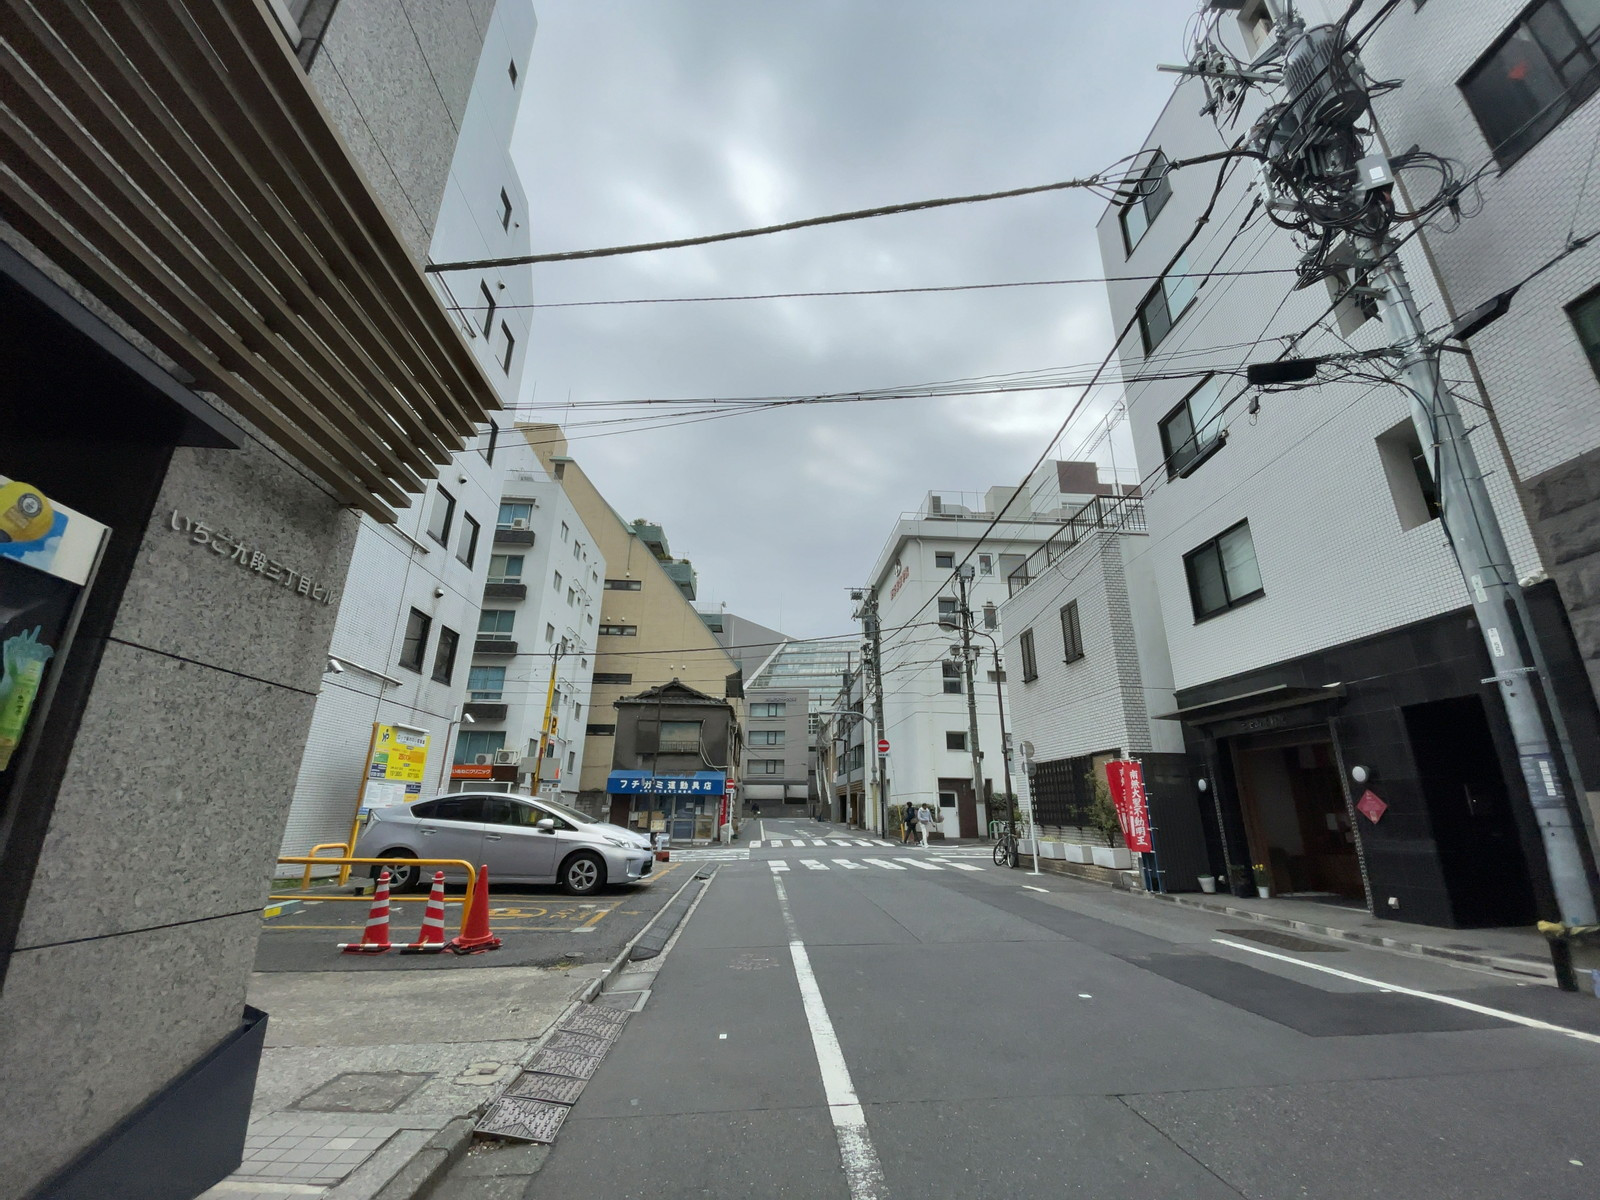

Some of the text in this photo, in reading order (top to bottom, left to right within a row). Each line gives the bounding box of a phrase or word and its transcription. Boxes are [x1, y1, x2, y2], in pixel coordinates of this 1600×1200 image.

[169, 508, 338, 607] いちご九段三丁目ビル
[620, 780, 712, 790] フチガミ運動具店
